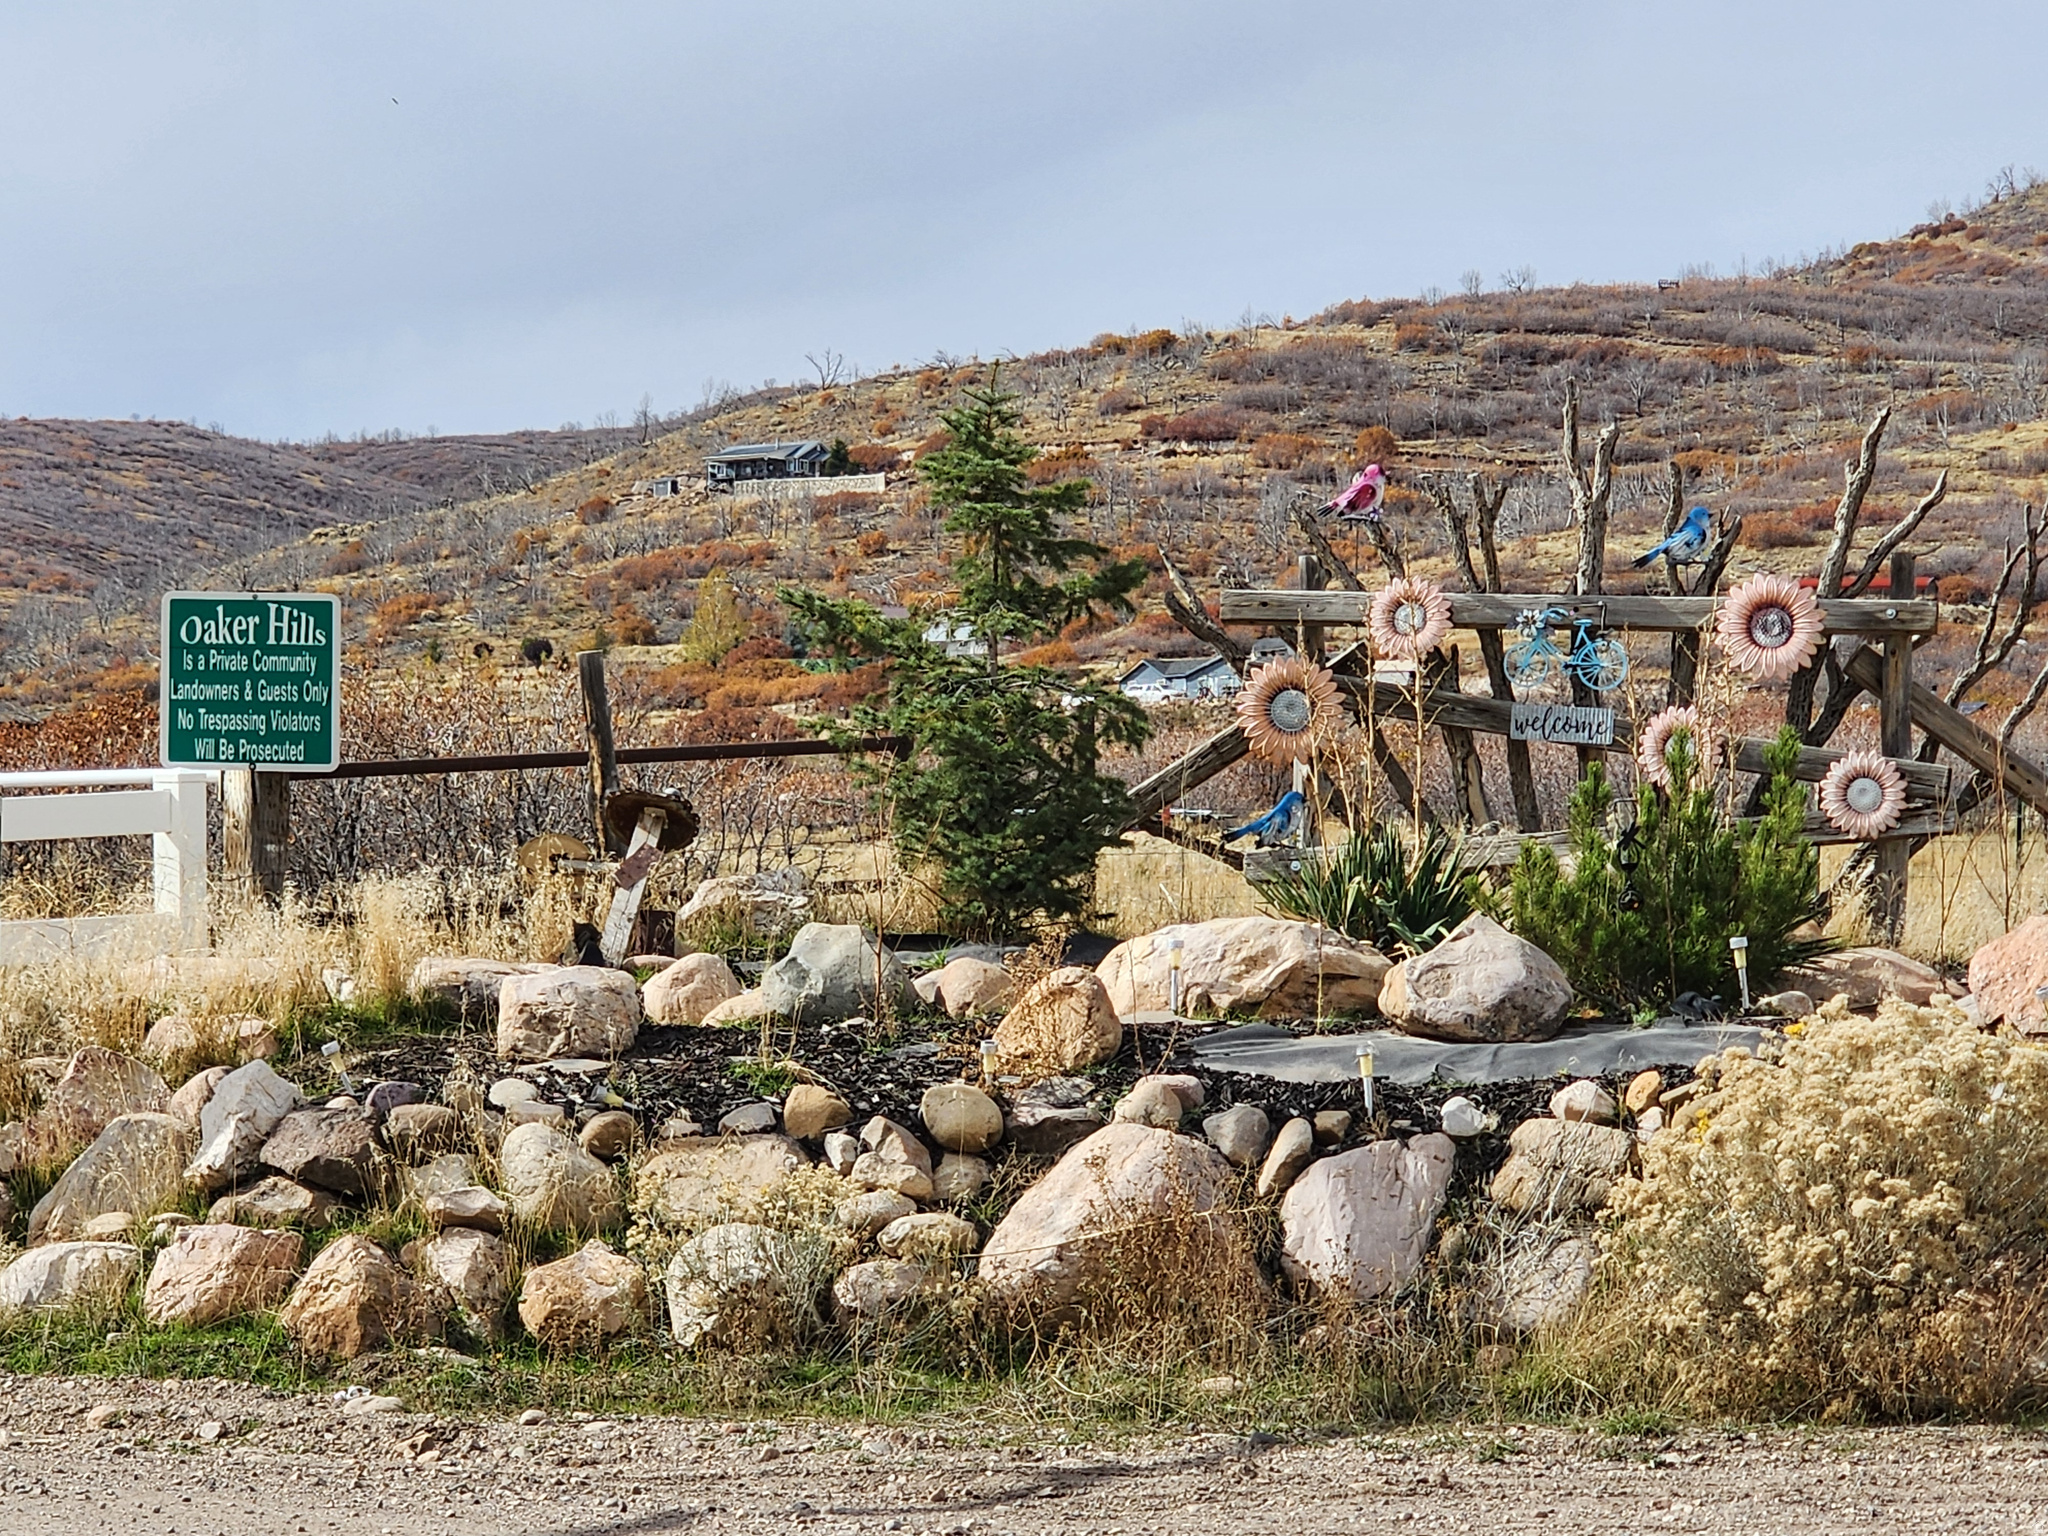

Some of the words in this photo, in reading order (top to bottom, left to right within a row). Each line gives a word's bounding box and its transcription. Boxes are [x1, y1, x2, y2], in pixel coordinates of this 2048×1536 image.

[180, 604, 260, 645] Oaker
[266, 602, 327, 646] Hills
[183, 649, 193, 671] Is
[198, 656, 205, 671] a
[209, 649, 248, 672] Private
[253, 650, 317, 676] Community
[170, 678, 239, 701] Landowners
[244, 679, 252, 701] &
[257, 679, 298, 702] Guests
[303, 680, 329, 706] Only
[177, 708, 194, 730] No
[198, 708, 266, 736] Trespassing
[270, 710, 321, 732] Violators
[1514, 706, 1610, 740] welcome
[194, 738, 215, 760] Will
[219, 738, 234, 761] Be
[239, 739, 304, 761] Prosecuted
